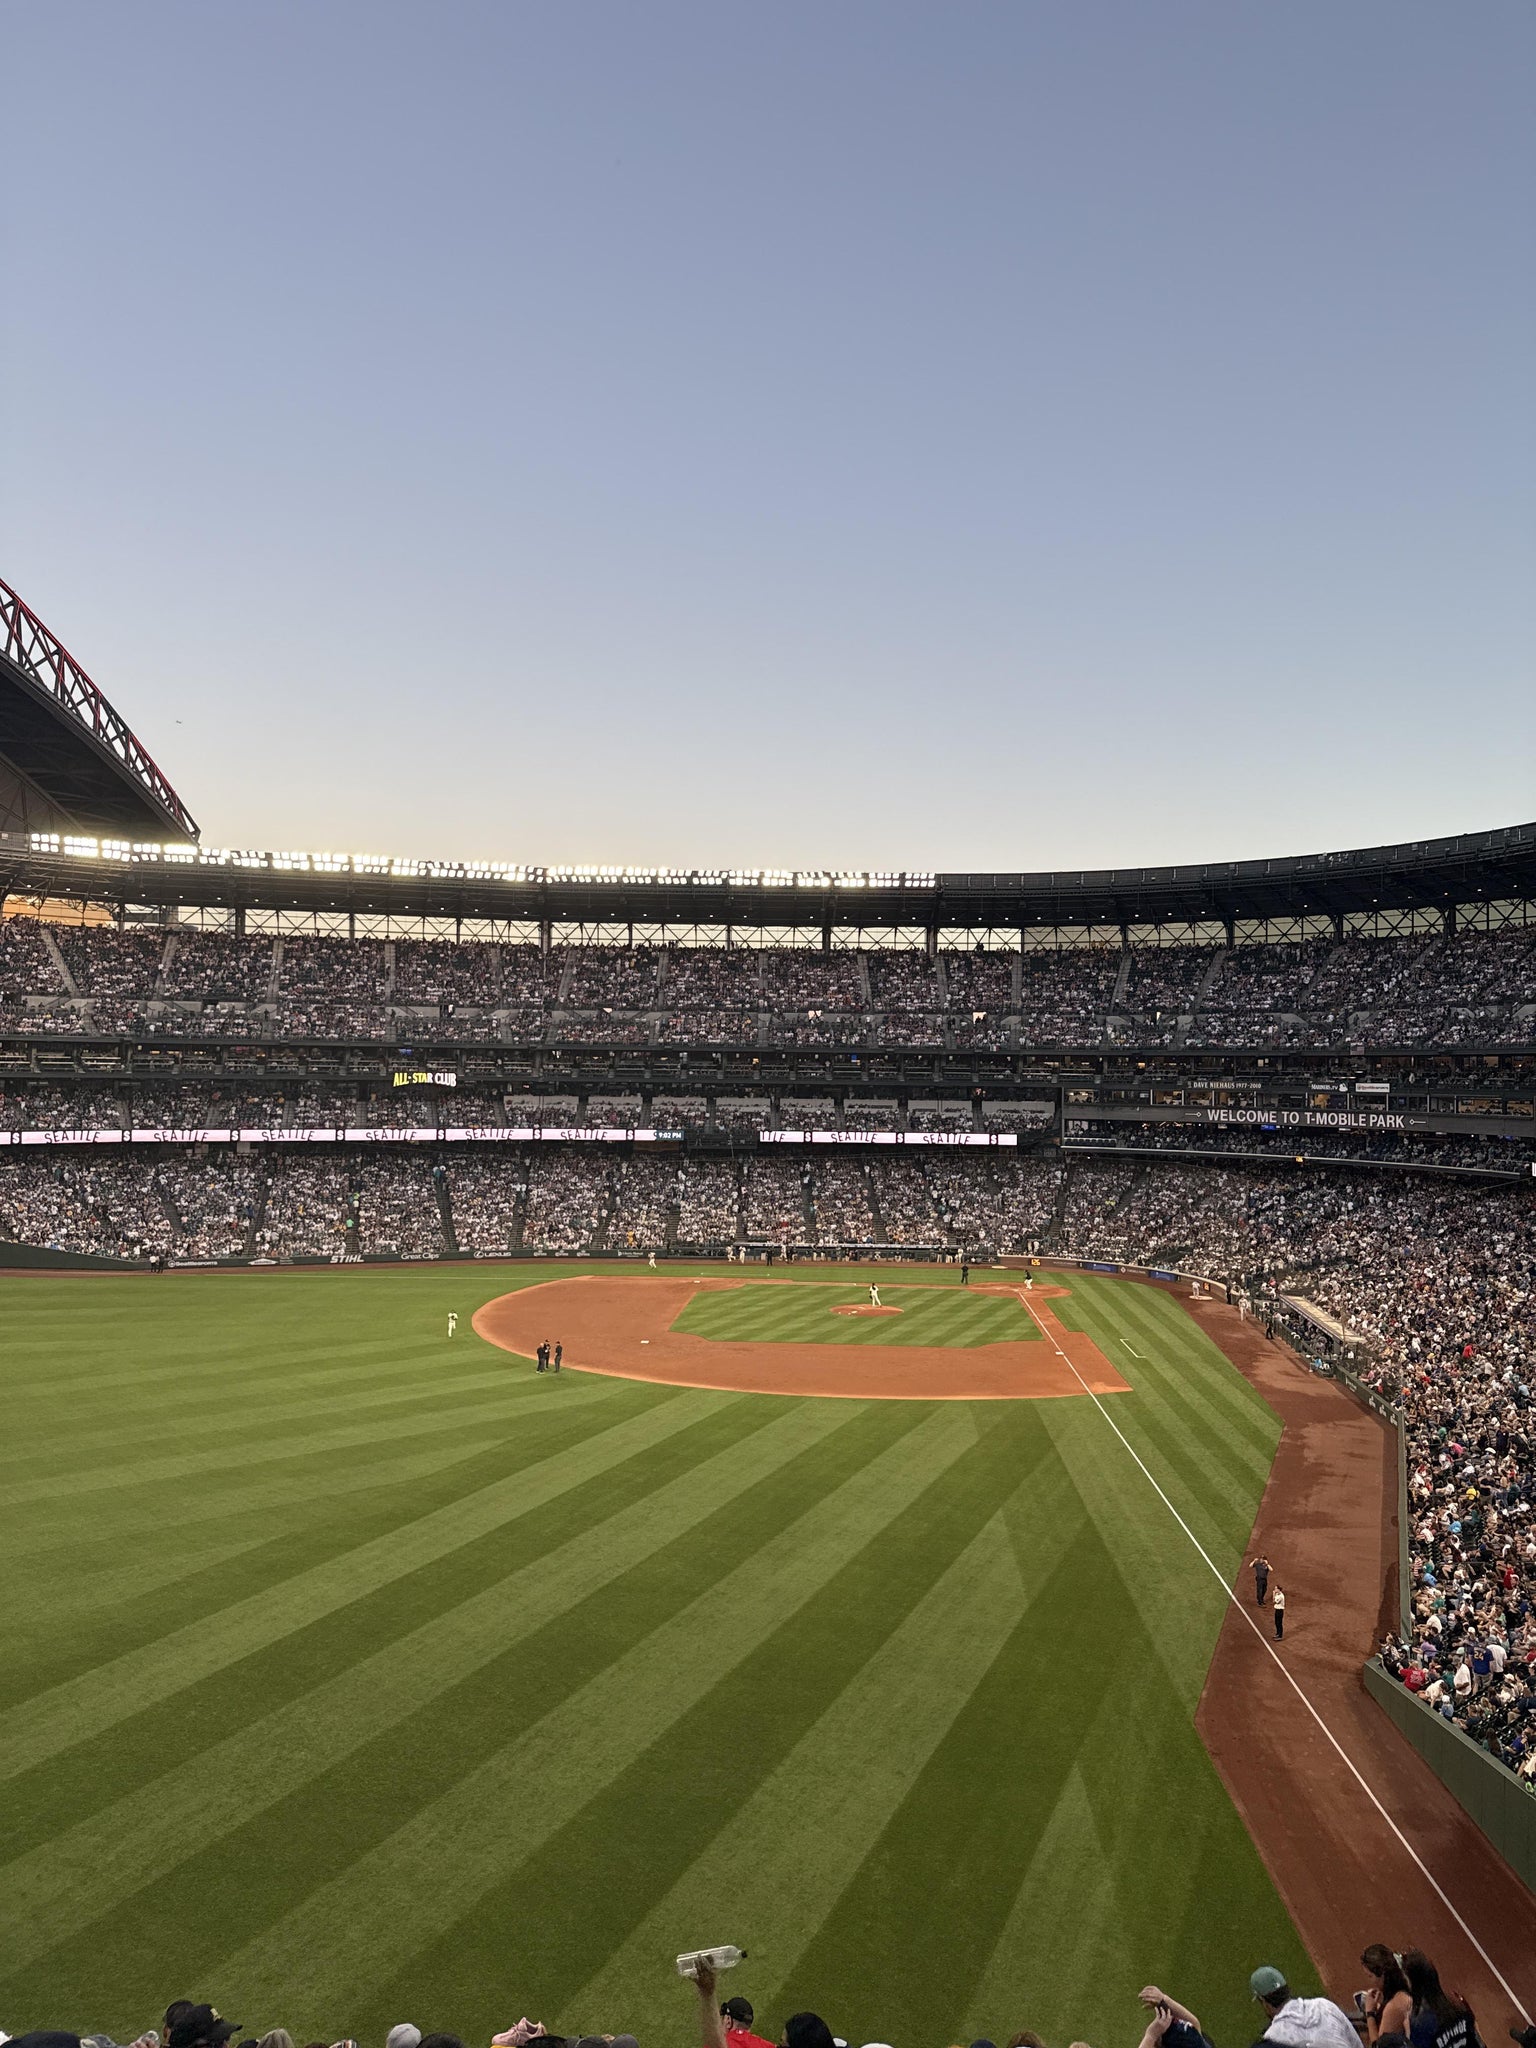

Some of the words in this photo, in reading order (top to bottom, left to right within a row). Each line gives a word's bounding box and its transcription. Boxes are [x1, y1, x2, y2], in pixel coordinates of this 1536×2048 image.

[434, 1072, 457, 1087] CLUB
[1193, 1081, 1208, 1089] DAVE
[1209, 1081, 1235, 1089] NIEHAUS
[1207, 1109, 1277, 1123] WELCOME
[1281, 1111, 1300, 1124] TO
[1304, 1112, 1367, 1127] T-MOBILE
[1369, 1115, 1405, 1129] PARK
[12, 1132, 20, 1144] S
[44, 1130, 100, 1143] SEATTLE
[123, 1130, 131, 1142] S
[153, 1130, 209, 1142] SEATTLE
[231, 1130, 239, 1141] S
[261, 1129, 315, 1141] SEATTLE
[336, 1129, 344, 1141] S
[365, 1129, 417, 1141] SEATTLE
[437, 1129, 445, 1140] S
[465, 1129, 514, 1141] SEATTLE
[534, 1129, 541, 1140] S
[560, 1129, 608, 1141] SEATTLE
[627, 1129, 634, 1140] S
[805, 1132, 812, 1142] S
[830, 1132, 877, 1143] SEATTLE
[897, 1133, 904, 1143] S
[923, 1133, 972, 1145] SEATTLE
[990, 1134, 998, 1145] S
[330, 1254, 365, 1263] STIHL
[401, 1252, 421, 1260] Great
[422, 1252, 440, 1260] Clips
